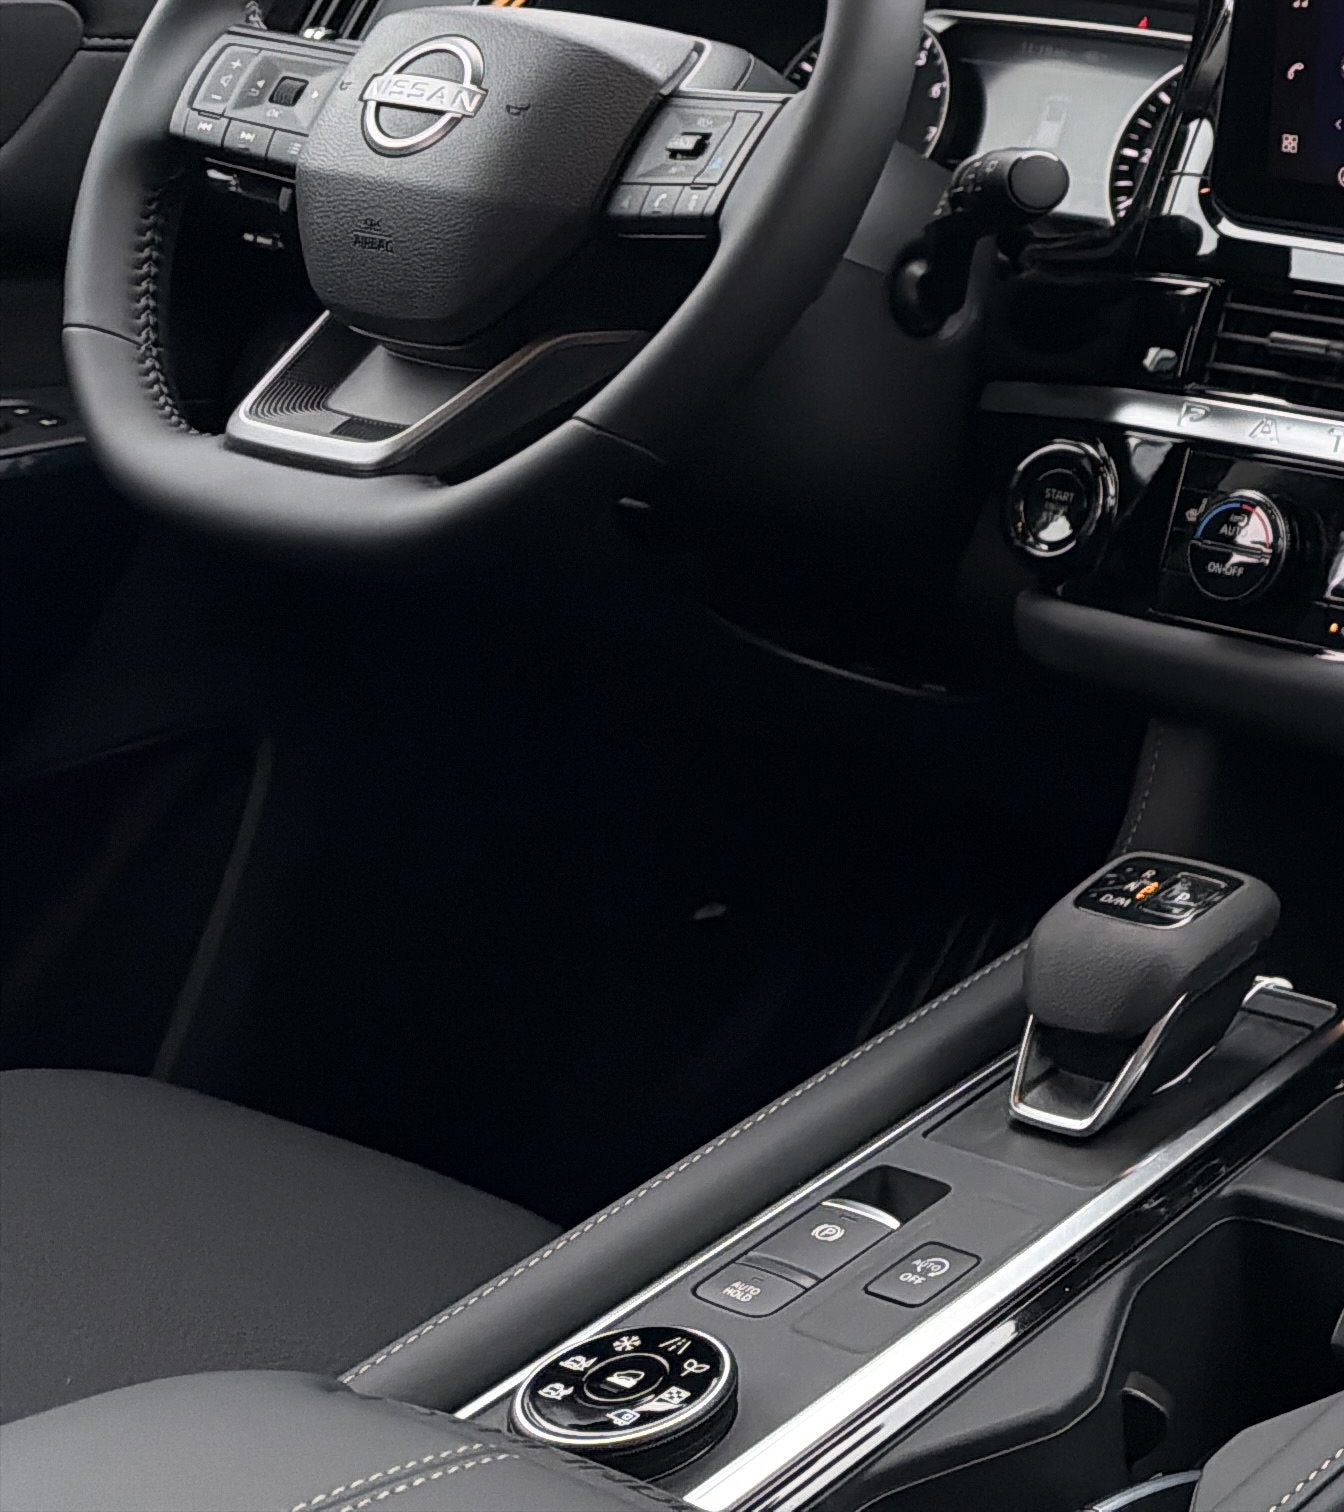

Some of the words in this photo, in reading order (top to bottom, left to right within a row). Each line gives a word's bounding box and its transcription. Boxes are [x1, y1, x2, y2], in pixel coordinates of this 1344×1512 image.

[365, 74, 482, 113] NISSAN
[930, 82, 942, 99] 6
[926, 126, 937, 142] 7
[1045, 488, 1075, 502] START
[1141, 869, 1156, 878] R
[1099, 893, 1132, 907] D/M
[911, 1258, 943, 1272] AUTO
[898, 1272, 927, 1286] OFF
[722, 1287, 753, 1303] HOLD
[731, 1280, 761, 1296] AUTO
